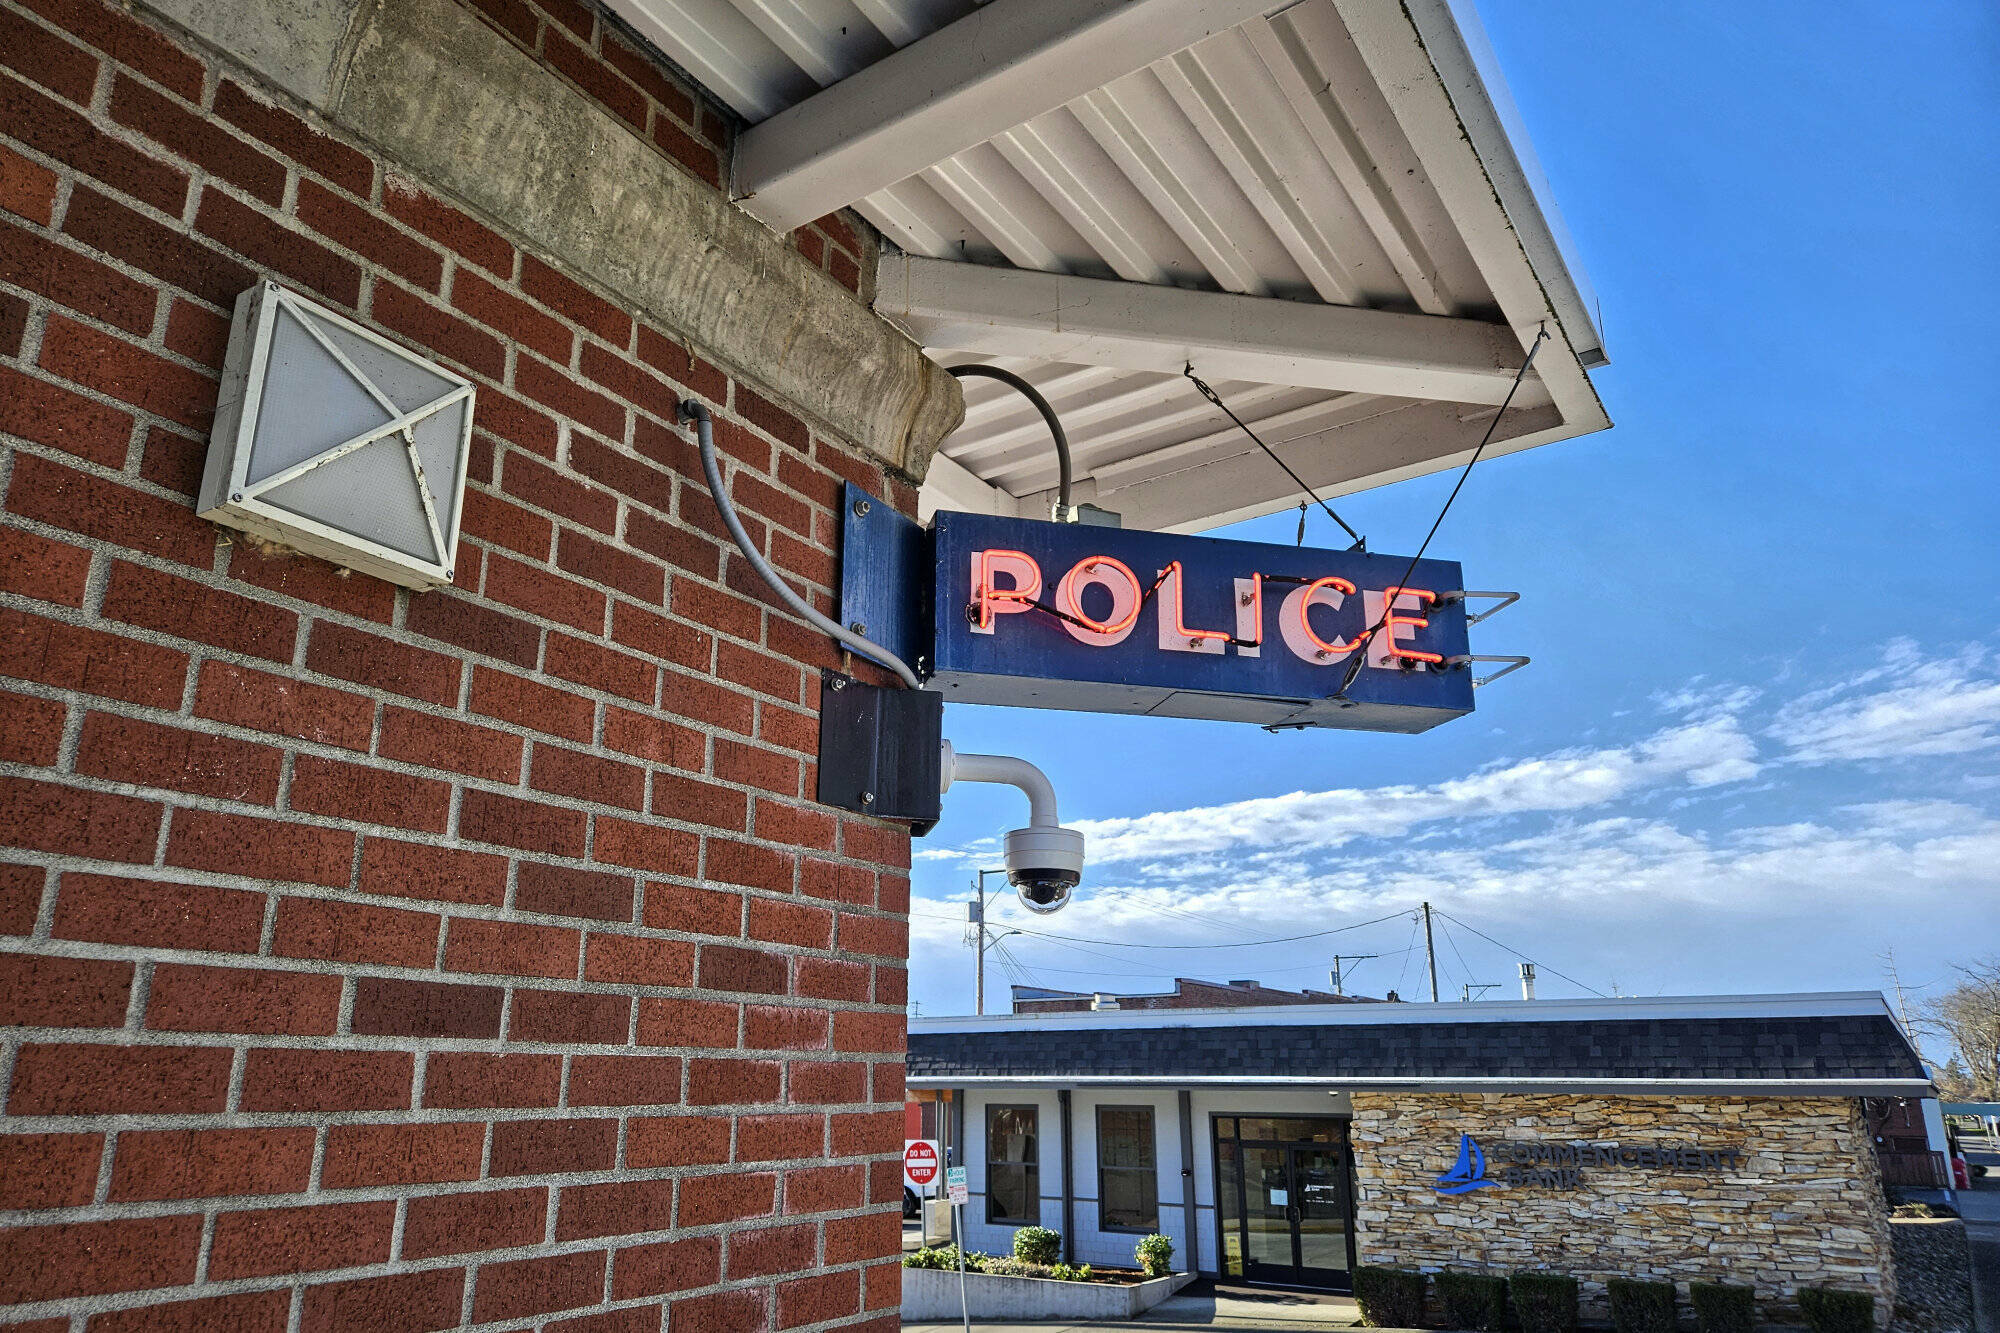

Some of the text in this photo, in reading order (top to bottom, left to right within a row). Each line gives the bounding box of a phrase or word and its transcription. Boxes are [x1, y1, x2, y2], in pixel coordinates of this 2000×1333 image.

[969, 550, 1443, 671] POLICE
[920, 1149, 932, 1157] NOT
[1492, 1142, 1740, 1171] COMMENCEMENT
[912, 1169, 931, 1177] ENTER
[1505, 1167, 1587, 1190] BANK
